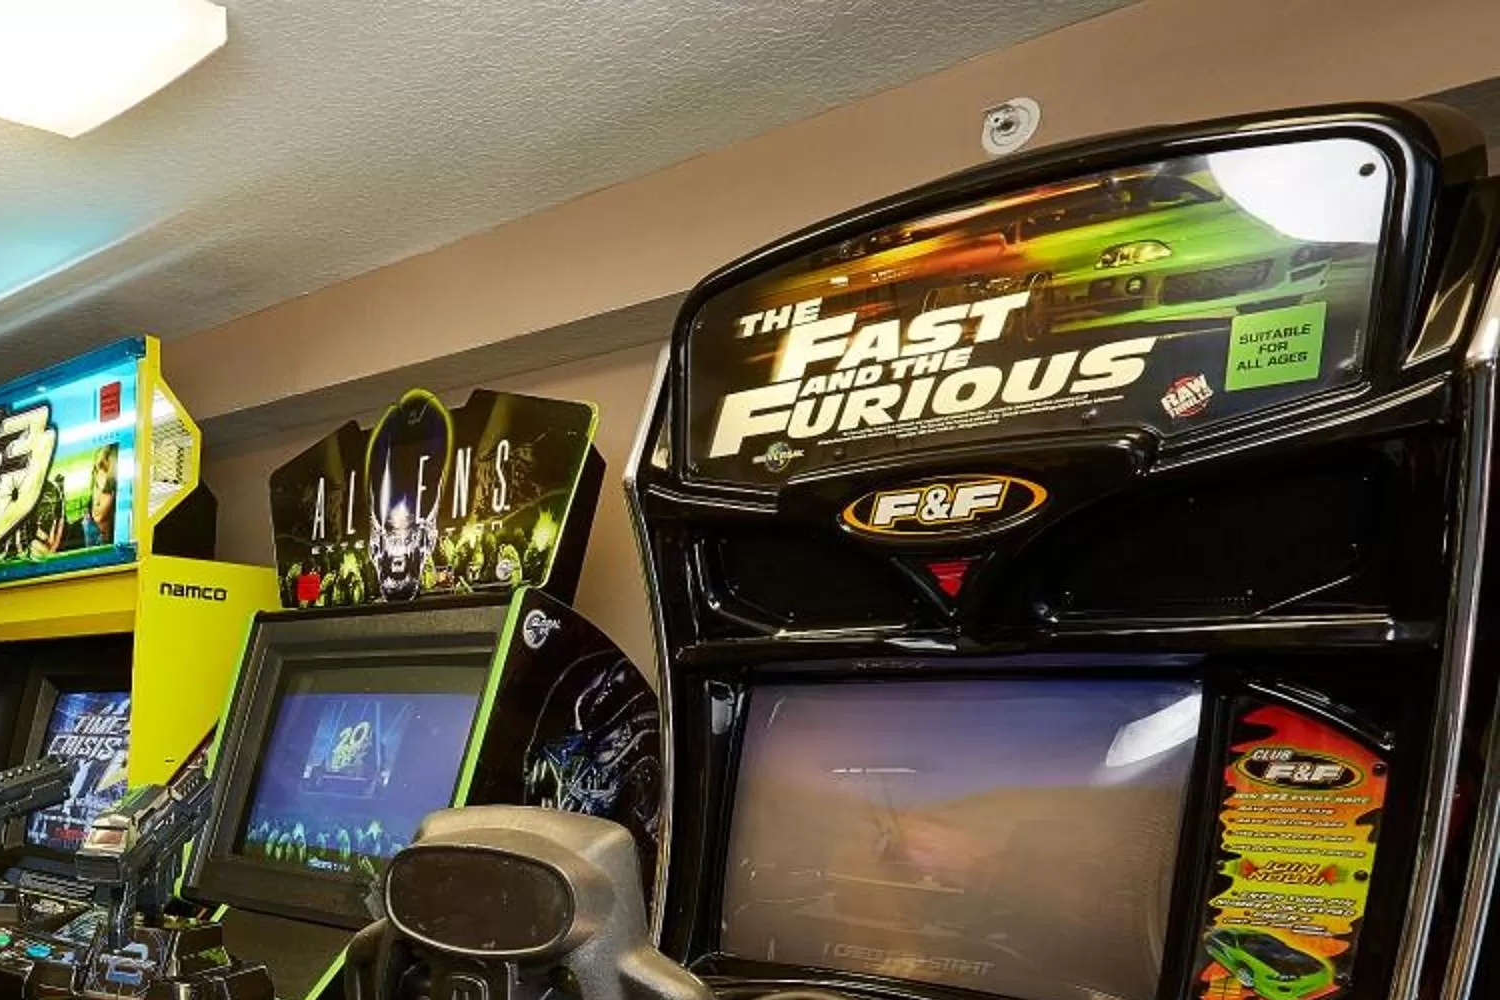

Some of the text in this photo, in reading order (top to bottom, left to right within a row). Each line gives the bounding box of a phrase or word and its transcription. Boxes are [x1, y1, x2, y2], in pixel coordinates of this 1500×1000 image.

[740, 297, 822, 338] THE
[775, 291, 1031, 383] FAST
[1239, 323, 1313, 345] SUITABLE
[1258, 341, 1288, 354] FOR
[799, 346, 974, 397] AND THE
[1236, 351, 1308, 371] ALL AGES
[709, 336, 1157, 459] FURIOUS
[312, 439, 510, 541] ALIENS
[871, 480, 1006, 528] F&F
[160, 582, 228, 601] namco
[73, 715, 130, 735] TIME
[48, 735, 116, 760] CRISIS
[1252, 750, 1294, 761] CLUB
[1264, 762, 1345, 782] F&F
[1265, 862, 1320, 873] JOIN
